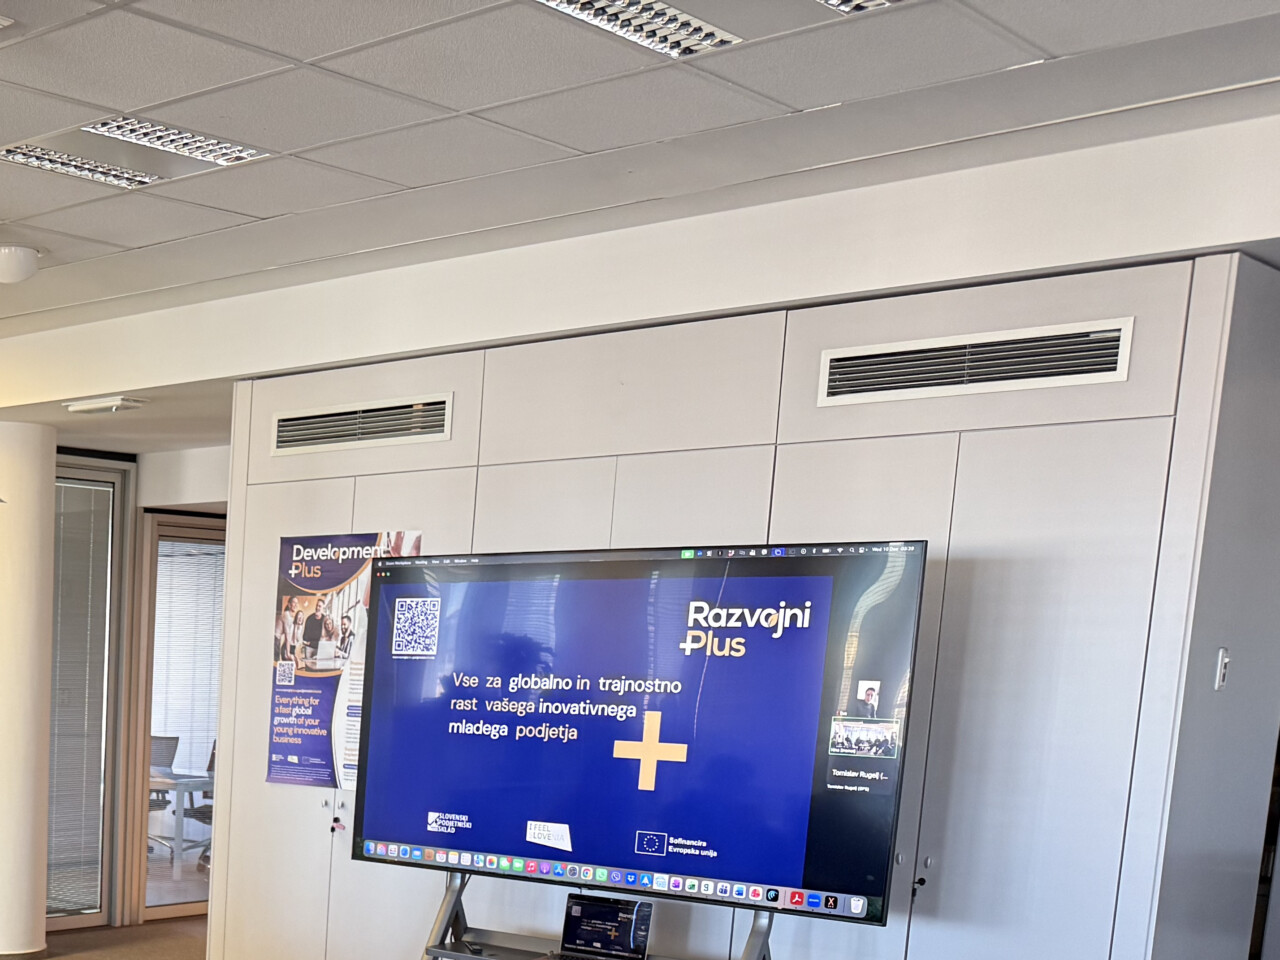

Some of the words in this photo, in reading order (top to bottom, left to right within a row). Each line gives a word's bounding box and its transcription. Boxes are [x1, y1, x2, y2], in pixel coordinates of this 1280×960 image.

[292, 543, 387, 563] Development
[687, 600, 812, 639] Razvojni
[453, 672, 479, 688] Vse
[486, 675, 502, 689] za
[508, 674, 573, 693] globalno
[576, 675, 591, 691] in
[598, 676, 682, 696] trajnostno
[275, 695, 309, 707] Everything
[310, 696, 320, 706] for
[280, 705, 291, 714] fast
[292, 705, 312, 718] global
[450, 698, 478, 711] rast
[485, 697, 536, 717] vašega
[538, 698, 637, 721] inovativnega
[273, 716, 297, 725] growth
[297, 716, 305, 725] of
[305, 718, 320, 727] your
[273, 726, 293, 736] young
[294, 725, 327, 736] innovative
[448, 719, 508, 740] mladega
[515, 722, 578, 743] podjetja
[273, 734, 302, 744] business
[439, 812, 469, 821] SLOVENSKI
[437, 826, 456, 834] SKLAD
[533, 823, 551, 832] FEEL
[669, 836, 707, 847] Sofinancira
[668, 845, 699, 855] Evropska
[700, 849, 718, 858] unija
